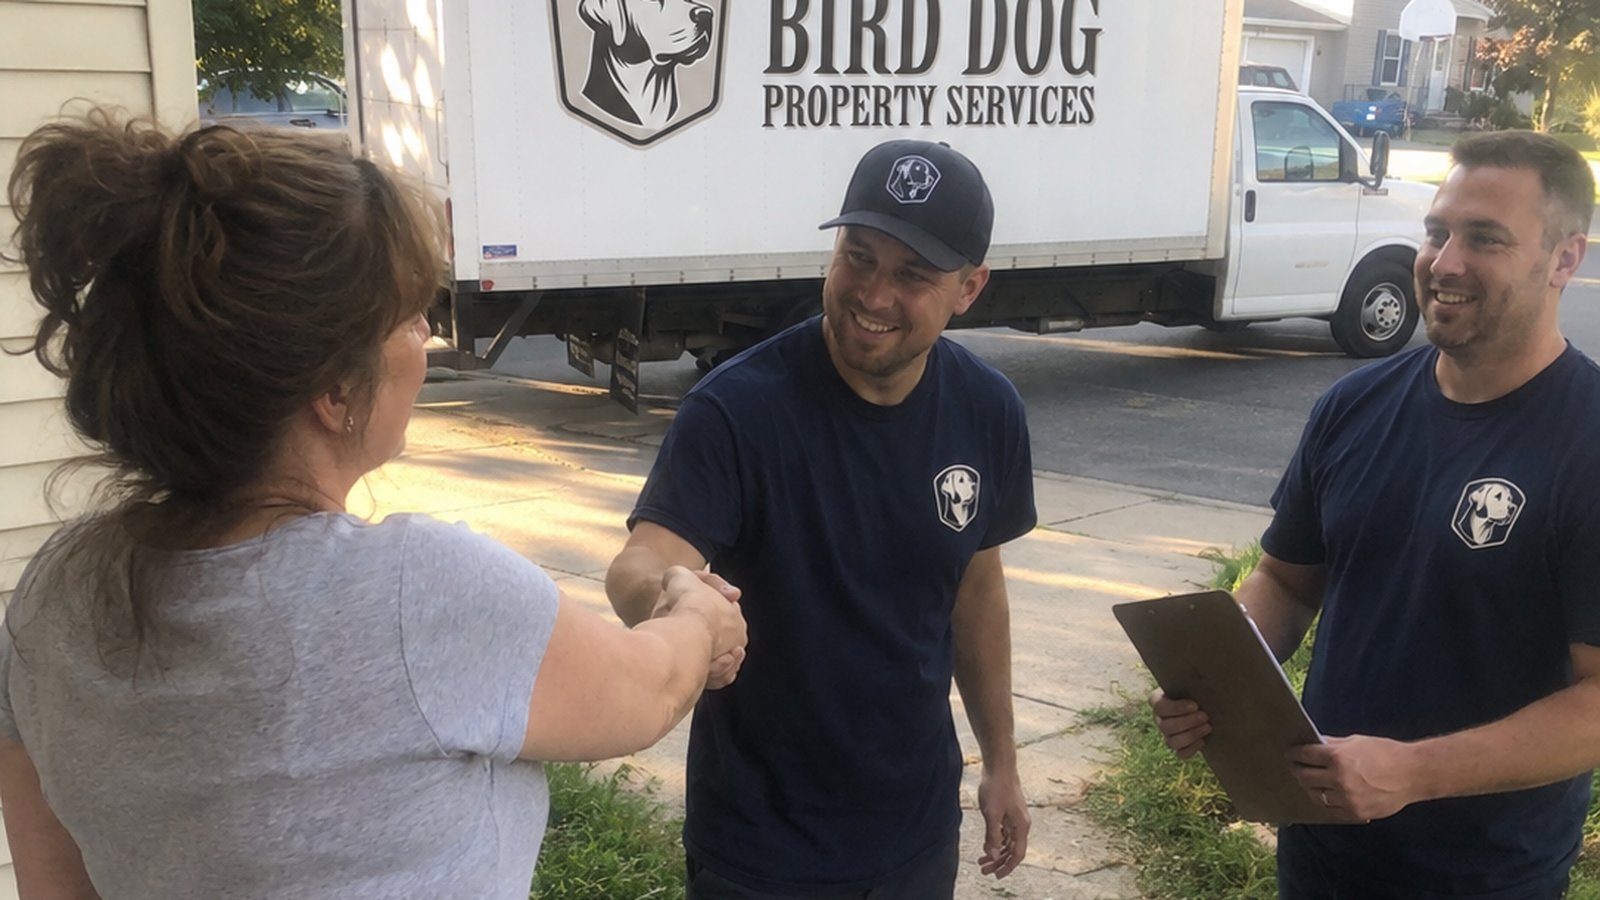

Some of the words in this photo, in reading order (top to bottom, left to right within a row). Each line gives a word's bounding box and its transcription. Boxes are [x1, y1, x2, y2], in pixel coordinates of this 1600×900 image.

[764, 0, 940, 75] BIRD
[962, 0, 1102, 76] DOG
[763, 85, 938, 127] PROPERTY
[947, 85, 1095, 126] SERVICES
